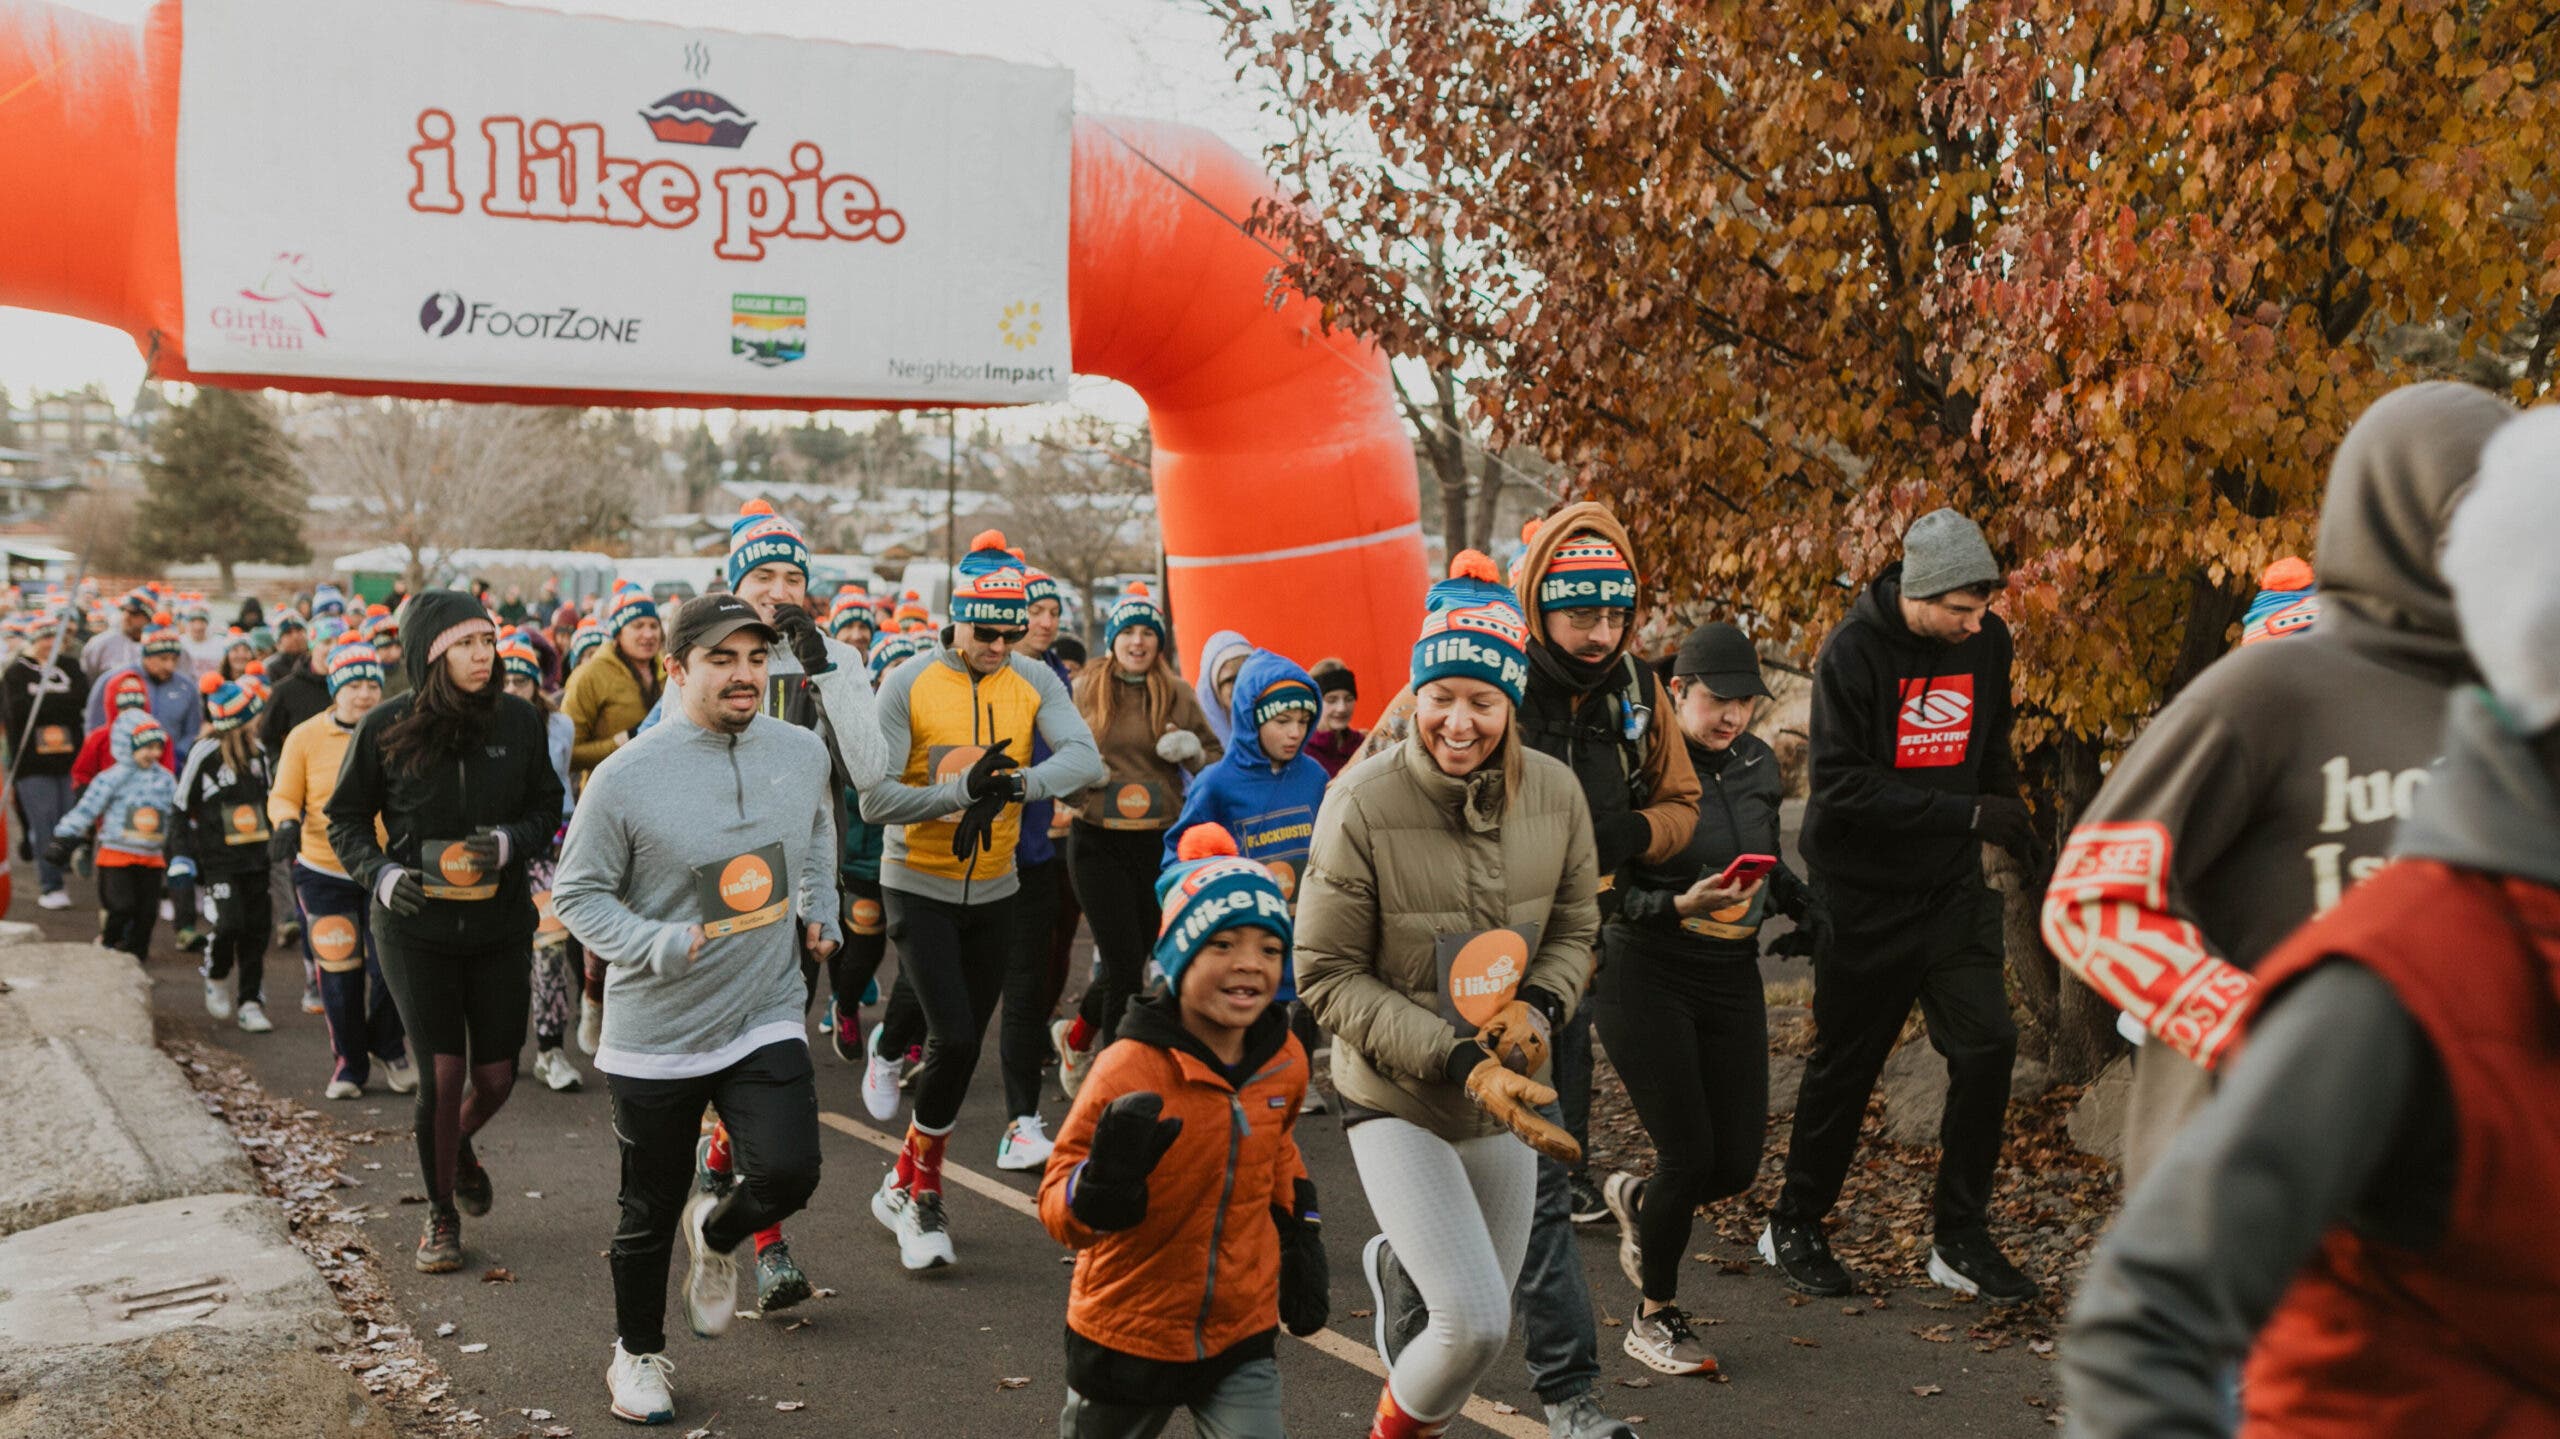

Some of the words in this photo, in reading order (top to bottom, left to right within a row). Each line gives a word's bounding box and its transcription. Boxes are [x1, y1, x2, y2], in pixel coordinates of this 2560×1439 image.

[409, 108, 464, 214] i
[481, 115, 702, 229] like
[715, 141, 906, 262] pie.
[210, 305, 285, 331] Girls
[250, 332, 304, 350] run
[888, 357, 1056, 384] NeighborImpact
[745, 540, 792, 563] like
[1541, 578, 1598, 603] like
[974, 603, 1015, 620] like
[1425, 643, 1435, 668] i
[1437, 637, 1502, 669] like
[1263, 700, 1302, 720] like
[1899, 729, 1971, 747] SELKIRK
[1907, 743, 1963, 757] SPORT
[1175, 927, 1190, 953] i
[1185, 890, 1255, 940] like
[1454, 977, 1462, 997] i
[1464, 975, 1501, 997] like
